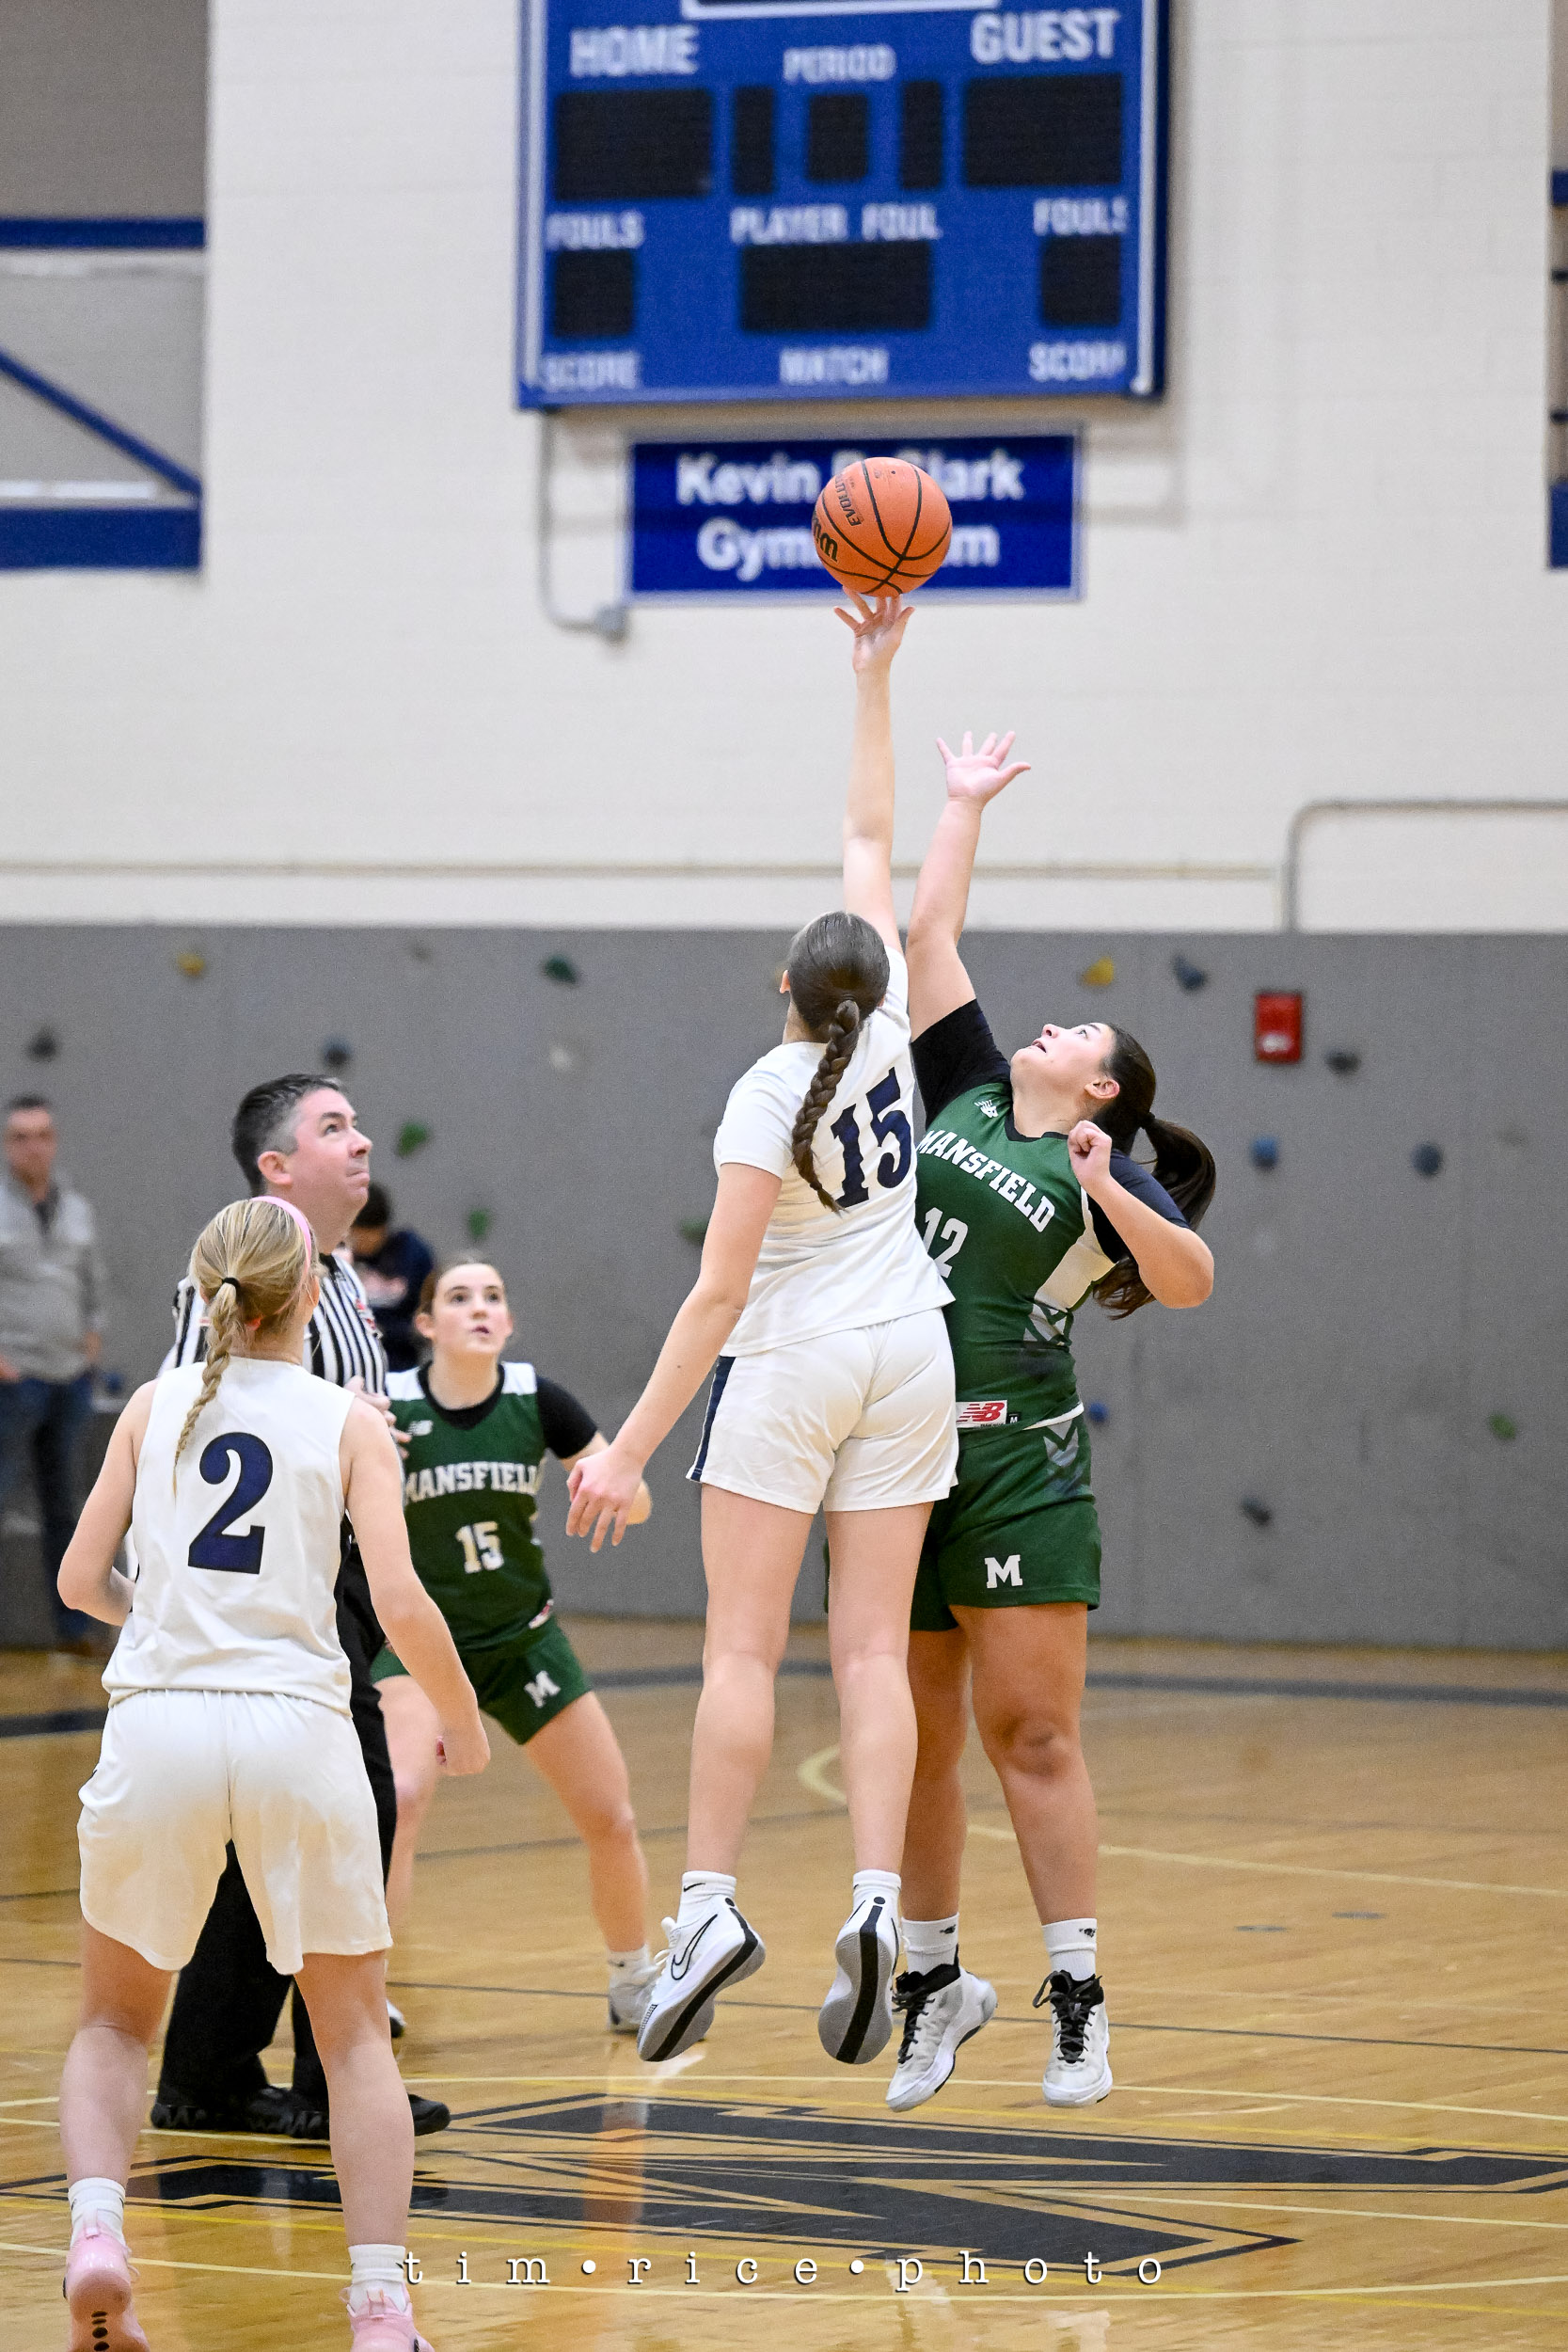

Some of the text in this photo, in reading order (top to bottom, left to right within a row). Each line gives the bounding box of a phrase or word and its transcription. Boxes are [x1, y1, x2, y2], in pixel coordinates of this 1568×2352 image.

[569, 24, 699, 77] HOME
[970, 8, 1121, 65] GUEST
[783, 43, 897, 85] PERIOD
[730, 200, 943, 246] PLAYER FOUL
[676, 450, 820, 504] Kevin
[831, 1067, 911, 1209] 15
[915, 1130, 1055, 1233] MANSFIELD
[923, 1207, 969, 1279] 12
[187, 1431, 274, 1575] 2
[455, 1520, 505, 1574] 15
[985, 1554, 1023, 1589] M
[523, 1670, 562, 1708] M
